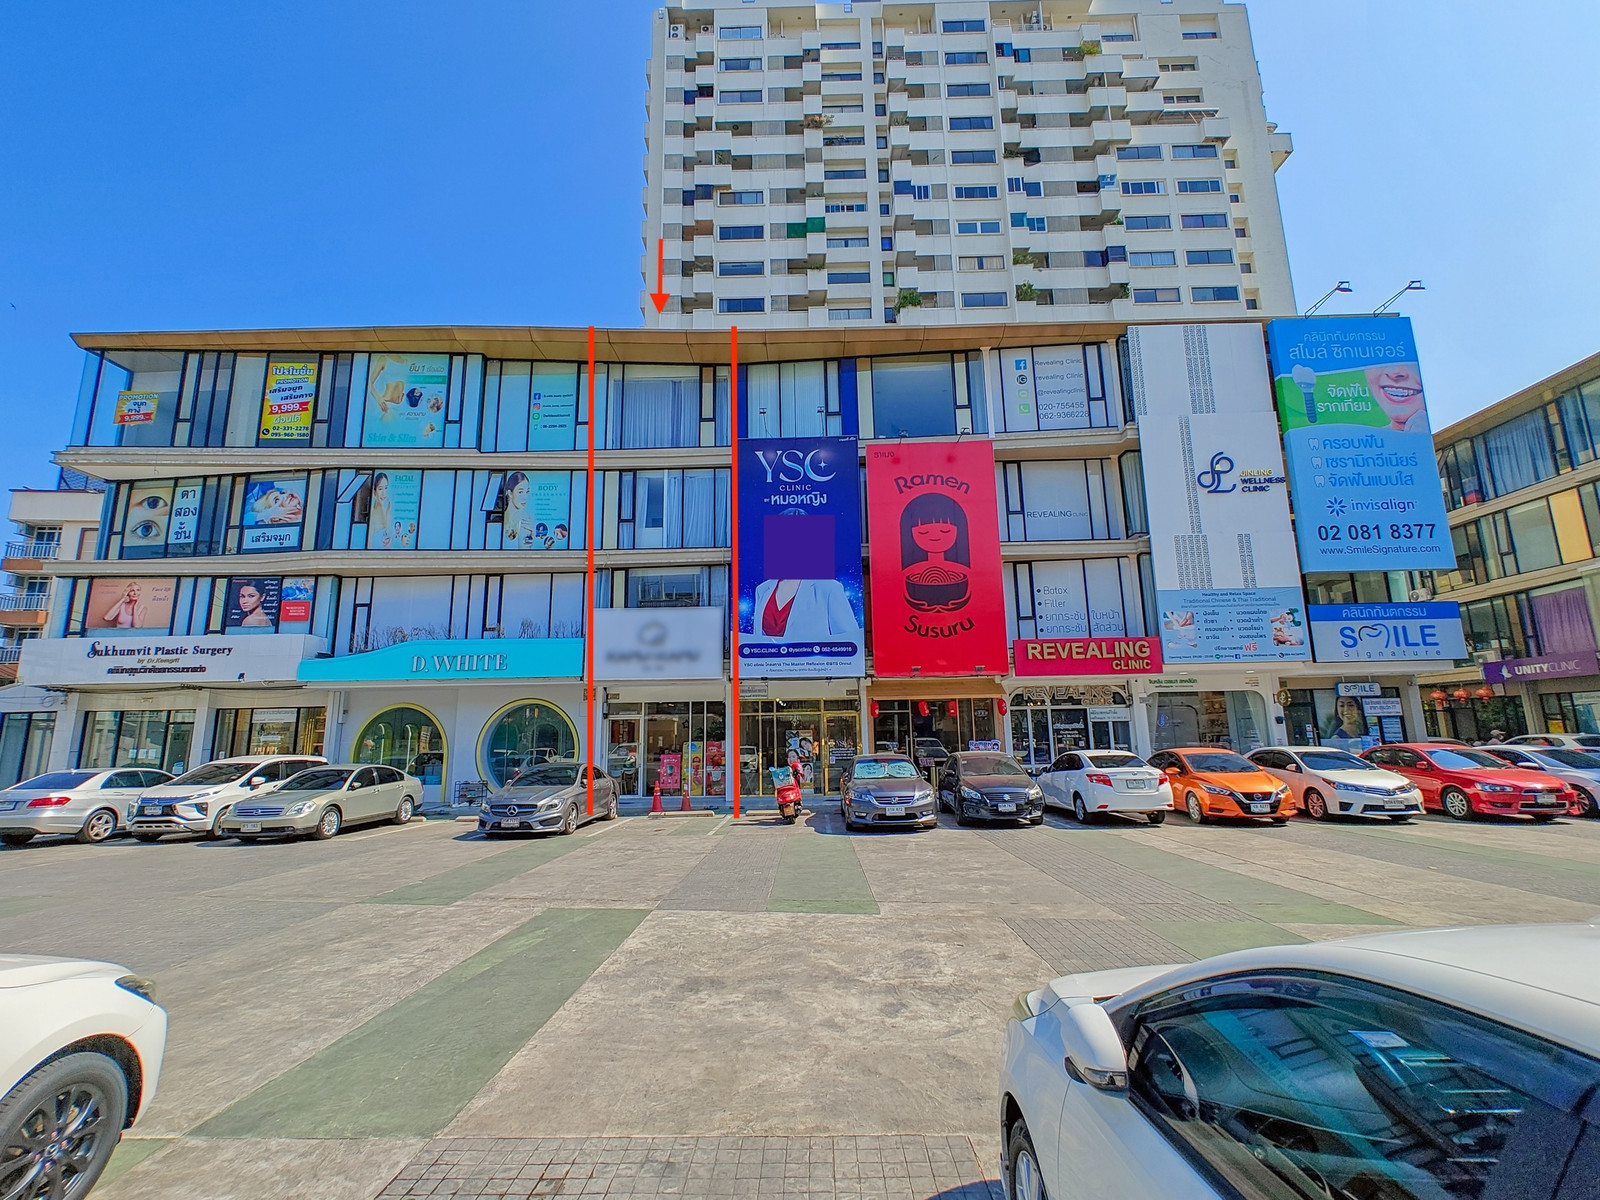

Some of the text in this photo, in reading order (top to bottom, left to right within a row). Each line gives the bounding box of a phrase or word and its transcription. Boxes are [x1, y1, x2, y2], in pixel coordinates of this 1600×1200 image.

[1303, 330, 1386, 342] คลินิกทันตกรรม
[1289, 342, 1406, 359] สไมล์ ซิกเนเจอร์
[1327, 383, 1369, 397] จัดฟัน
[1317, 399, 1372, 412] รากเทียม
[1322, 434, 1385, 450] ครอบฟัน
[1325, 452, 1418, 469] เซรามิกวีเนียร์
[894, 473, 970, 494] Ramen
[1328, 470, 1414, 487] จัดฟันแบบใส
[181, 489, 196, 499] ตา
[771, 492, 827, 506] หมอหญิง
[1351, 498, 1416, 512] invisalign
[174, 507, 197, 518] สอง
[173, 521, 192, 540] ชั้น
[1317, 523, 1436, 541] 02 081 8377
[251, 532, 291, 546] เสริมจมูก
[1320, 544, 1441, 556] www.SmileSignature.com
[1043, 586, 1068, 595] Botox
[1044, 599, 1066, 608] Filler
[1342, 606, 1427, 618] คลินิกทันตกรรม
[904, 614, 976, 638] Susuru
[1339, 623, 1440, 648] SMILE
[87, 641, 233, 658] Sukhumvit Plastic Surgery
[1026, 641, 1151, 660] REVEALING
[1244, 642, 1258, 651] ฟรี
[1343, 650, 1441, 658] Signature
[432, 654, 508, 672] WHITE
[1112, 660, 1152, 670] CLINIC
[1514, 660, 1581, 675] UNITY CLINIC
[1022, 685, 1114, 700] REVEALING
[1081, 698, 1113, 706] CLINIC
